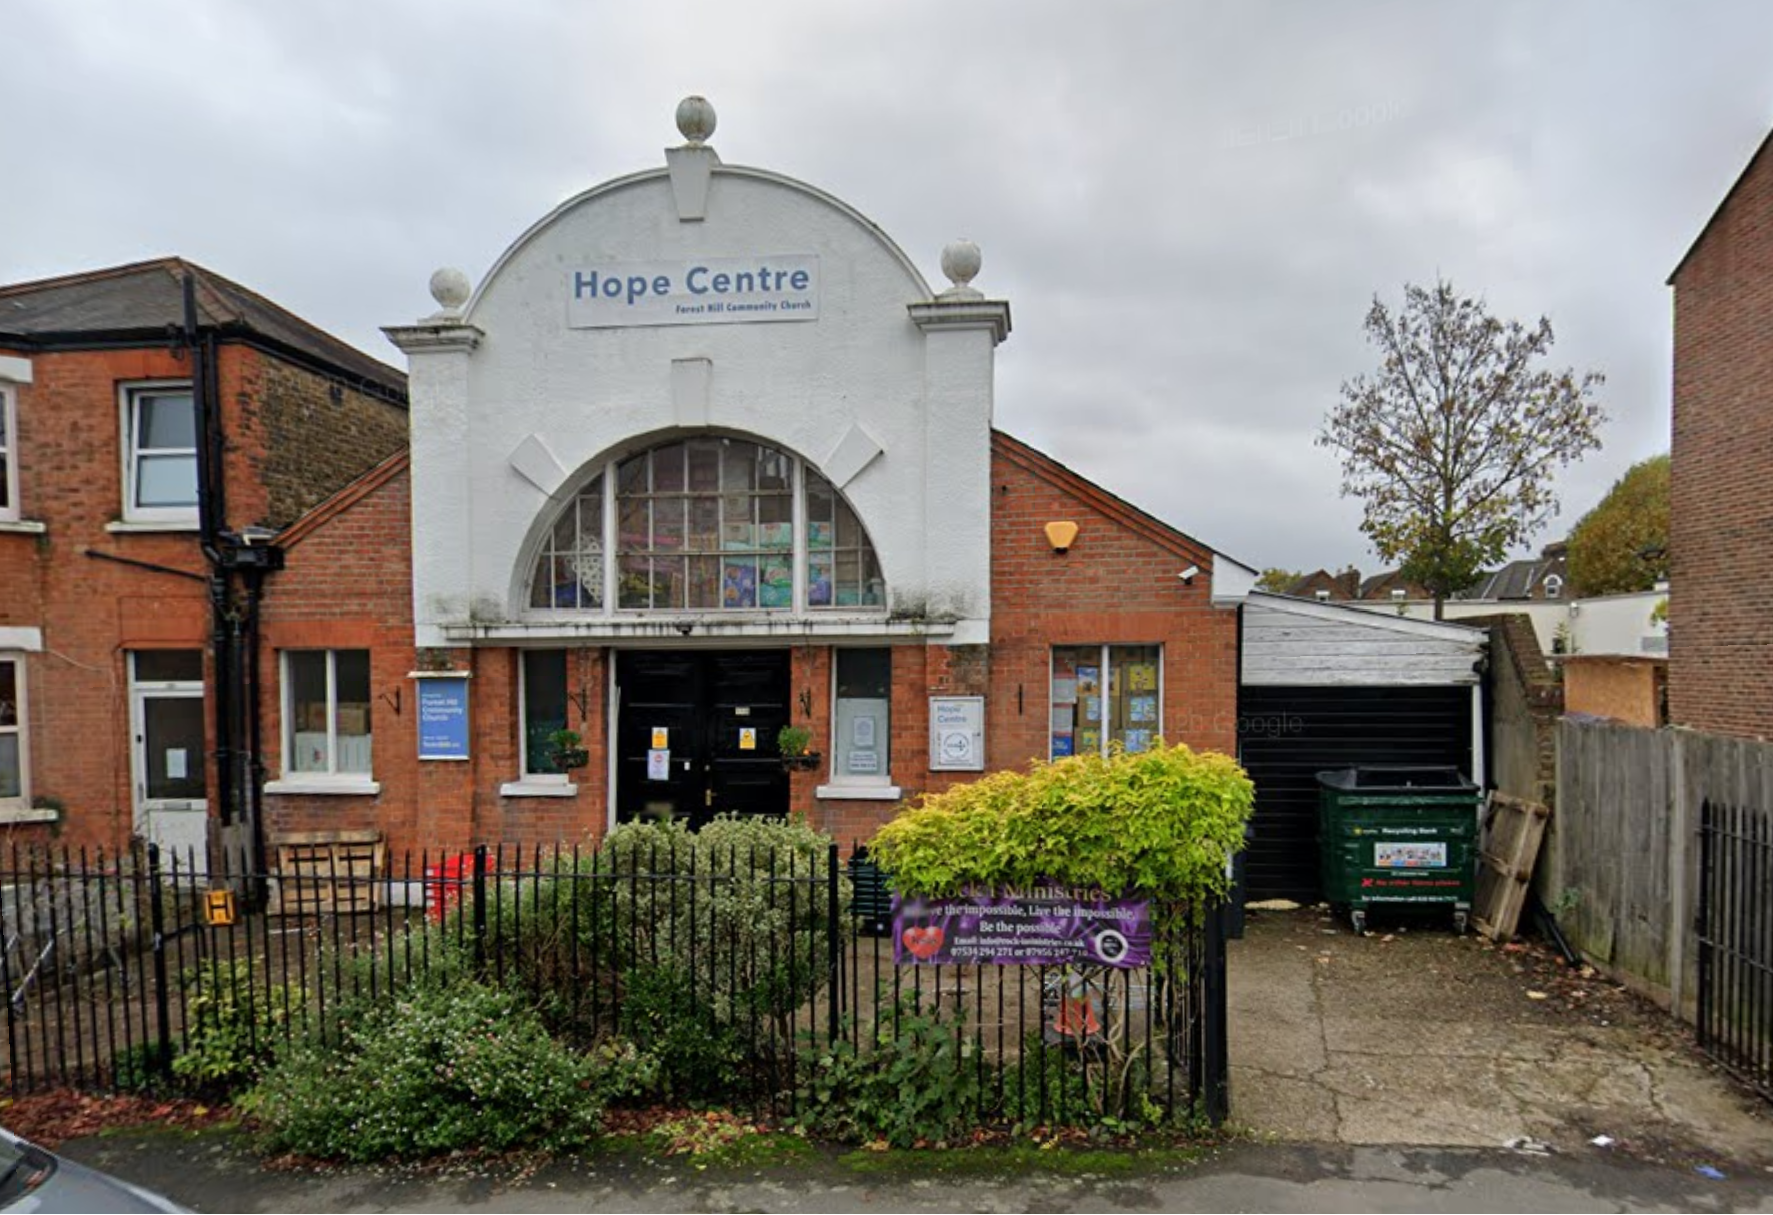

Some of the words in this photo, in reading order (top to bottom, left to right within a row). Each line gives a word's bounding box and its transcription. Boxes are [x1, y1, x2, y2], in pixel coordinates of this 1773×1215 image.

[574, 270, 671, 305] Hope
[685, 266, 810, 295] Centre
[675, 304, 705, 314] Forest
[707, 303, 724, 313] Hill
[726, 301, 778, 312] Community
[780, 299, 811, 311] Church
[937, 715, 968, 724] Centre
[208, 893, 231, 920] H
[944, 903, 963, 916] the
[964, 904, 1027, 918] impossible,
[1028, 903, 1050, 916] Live
[1052, 903, 1072, 917] the
[979, 920, 995, 933] Be
[996, 920, 1015, 933] the
[1016, 921, 1063, 937] possible
[1014, 949, 1025, 957] or
